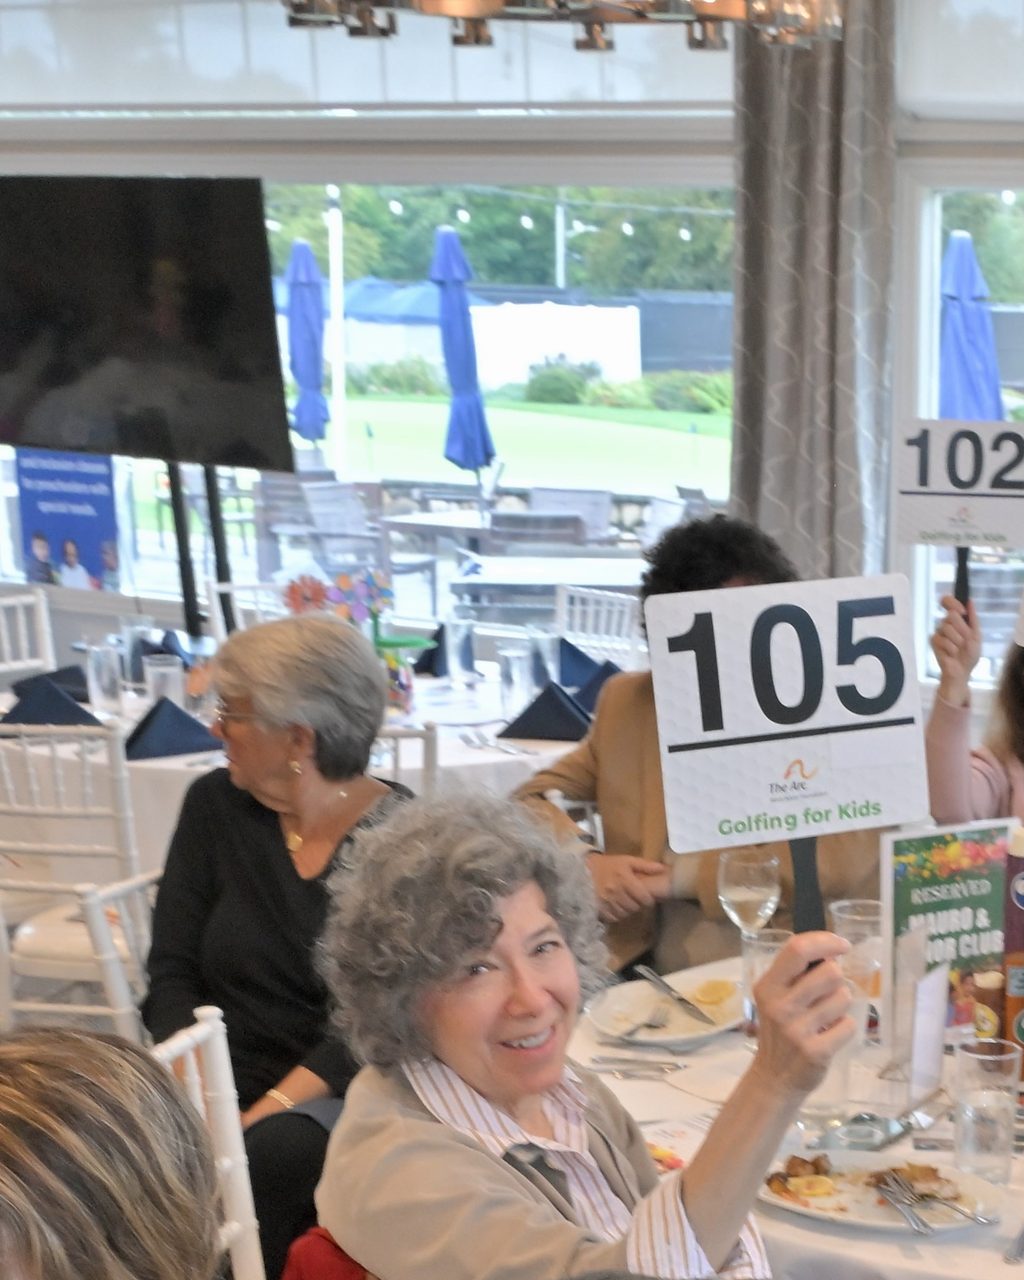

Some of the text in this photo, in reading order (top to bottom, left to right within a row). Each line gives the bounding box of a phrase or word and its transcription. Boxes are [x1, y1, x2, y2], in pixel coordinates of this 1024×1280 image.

[667, 596, 905, 732] 105
[769, 780, 808, 793] The Arc
[718, 800, 882, 836] Golfing for Kids
[910, 879, 992, 905] RESERVED
[975, 907, 991, 929] &
[958, 930, 1005, 959] CLUB
